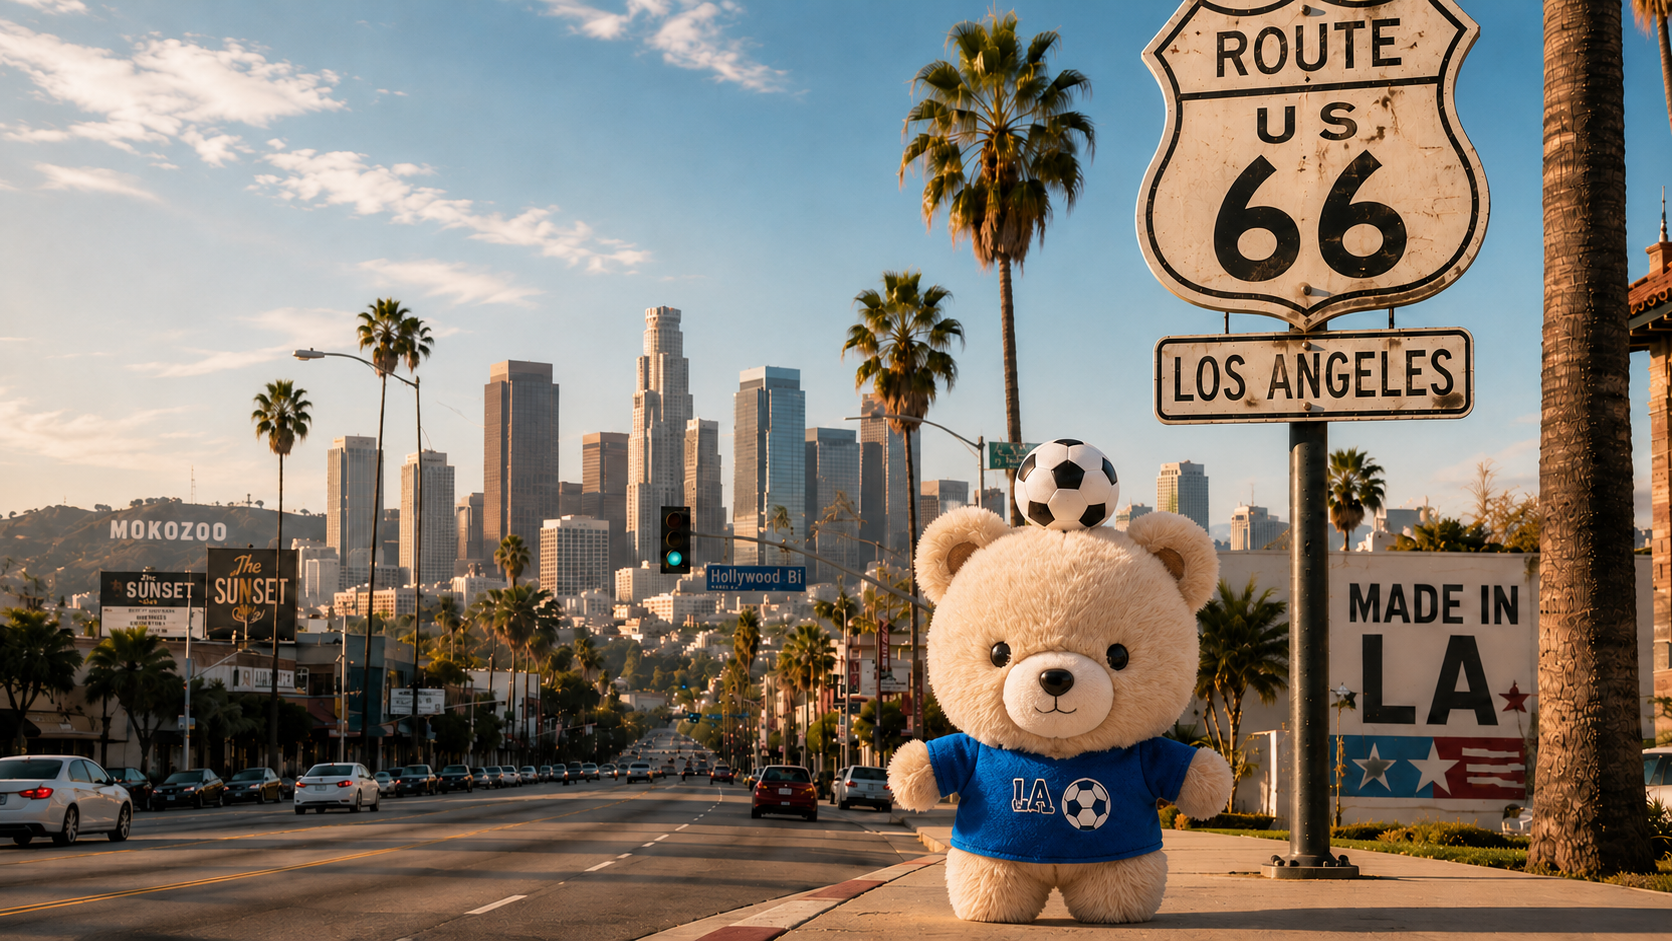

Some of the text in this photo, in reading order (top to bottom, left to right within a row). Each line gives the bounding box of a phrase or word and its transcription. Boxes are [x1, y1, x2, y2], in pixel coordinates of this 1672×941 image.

[1216, 18, 1402, 78] ROUTE
[1214, 150, 1407, 282] 66
[1174, 348, 1454, 402] LOS ANGELES
[110, 519, 227, 541] MOKOZOO
[230, 554, 262, 577] The
[711, 568, 780, 586] Hollywood
[126, 581, 195, 599] SUNSET
[214, 577, 289, 605] SUNSET
[1349, 583, 1519, 625] MADE IN
[1362, 633, 1499, 726] LA
[1011, 778, 1056, 814] LA
